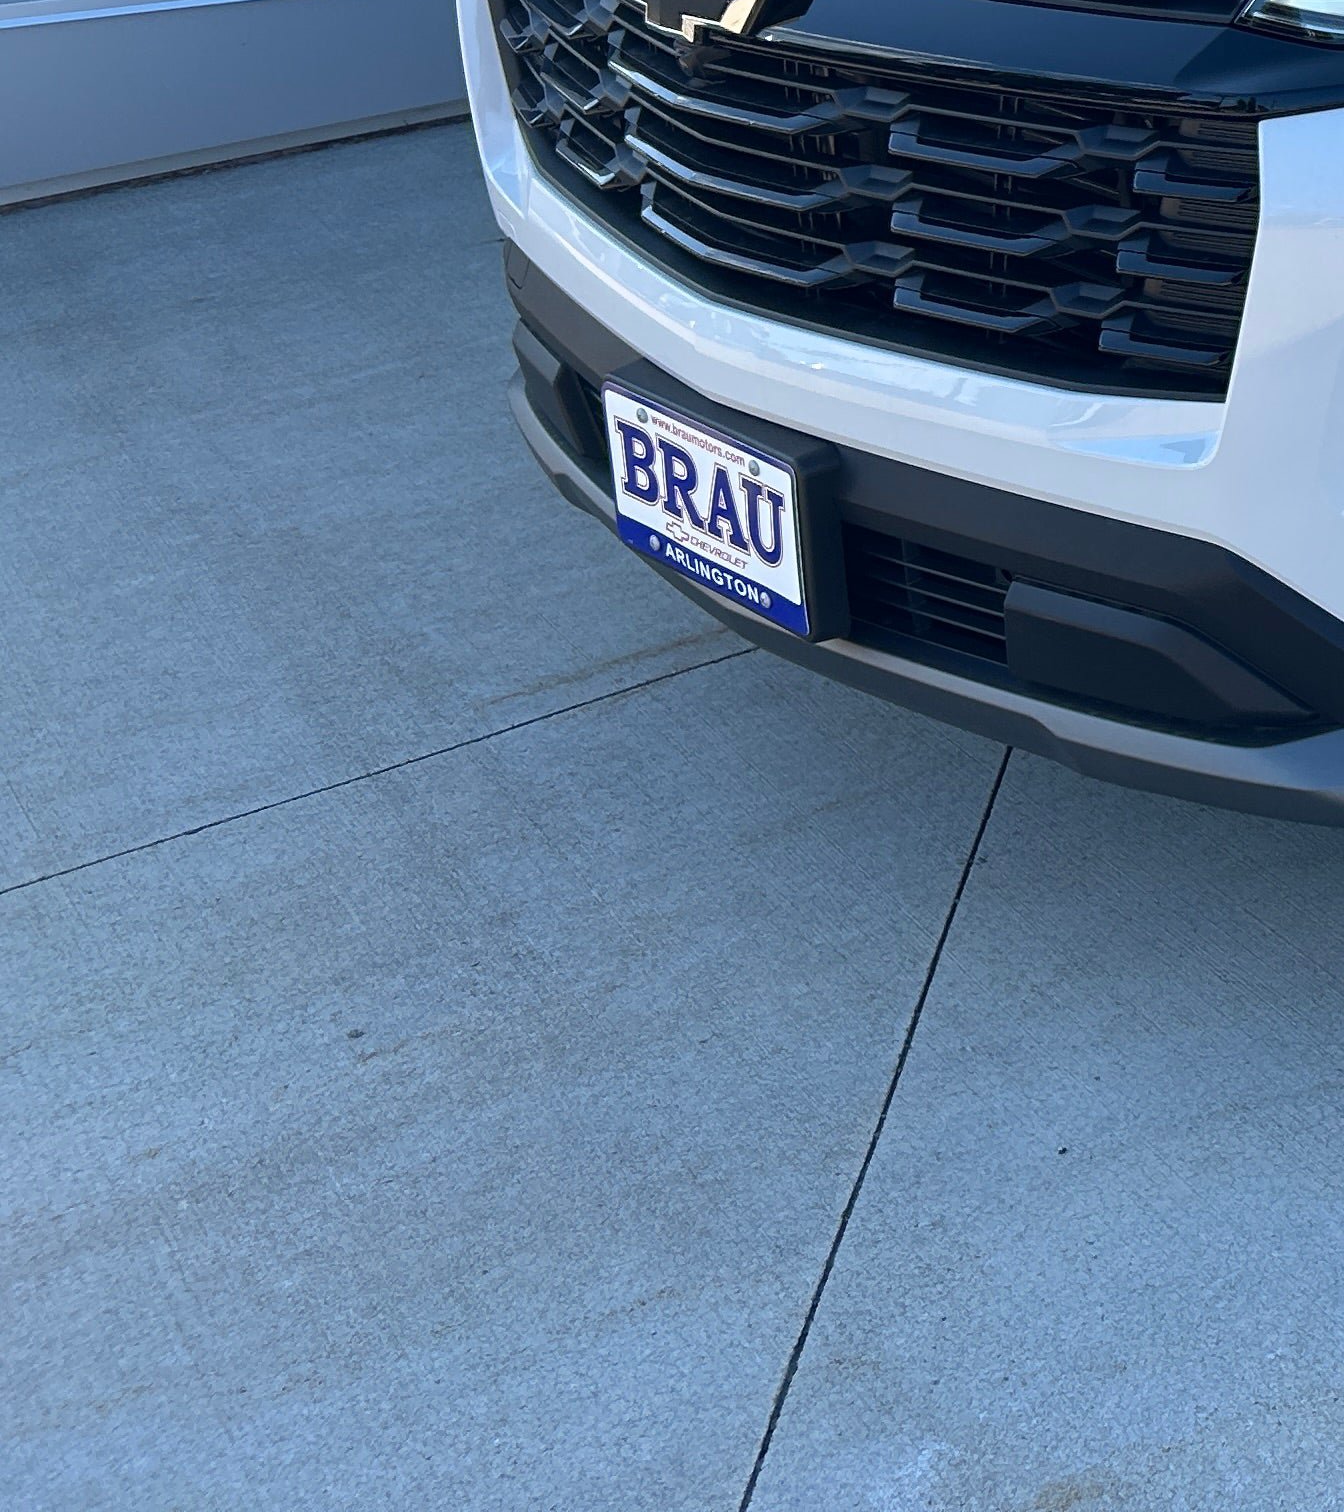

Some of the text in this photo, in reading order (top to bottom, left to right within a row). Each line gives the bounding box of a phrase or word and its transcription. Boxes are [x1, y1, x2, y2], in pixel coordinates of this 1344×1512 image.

[650, 414, 745, 467] www.braumotors.com
[614, 415, 786, 568] BRAU
[665, 542, 760, 605] ARLINGTON
[690, 535, 748, 570] CHEVROLET
